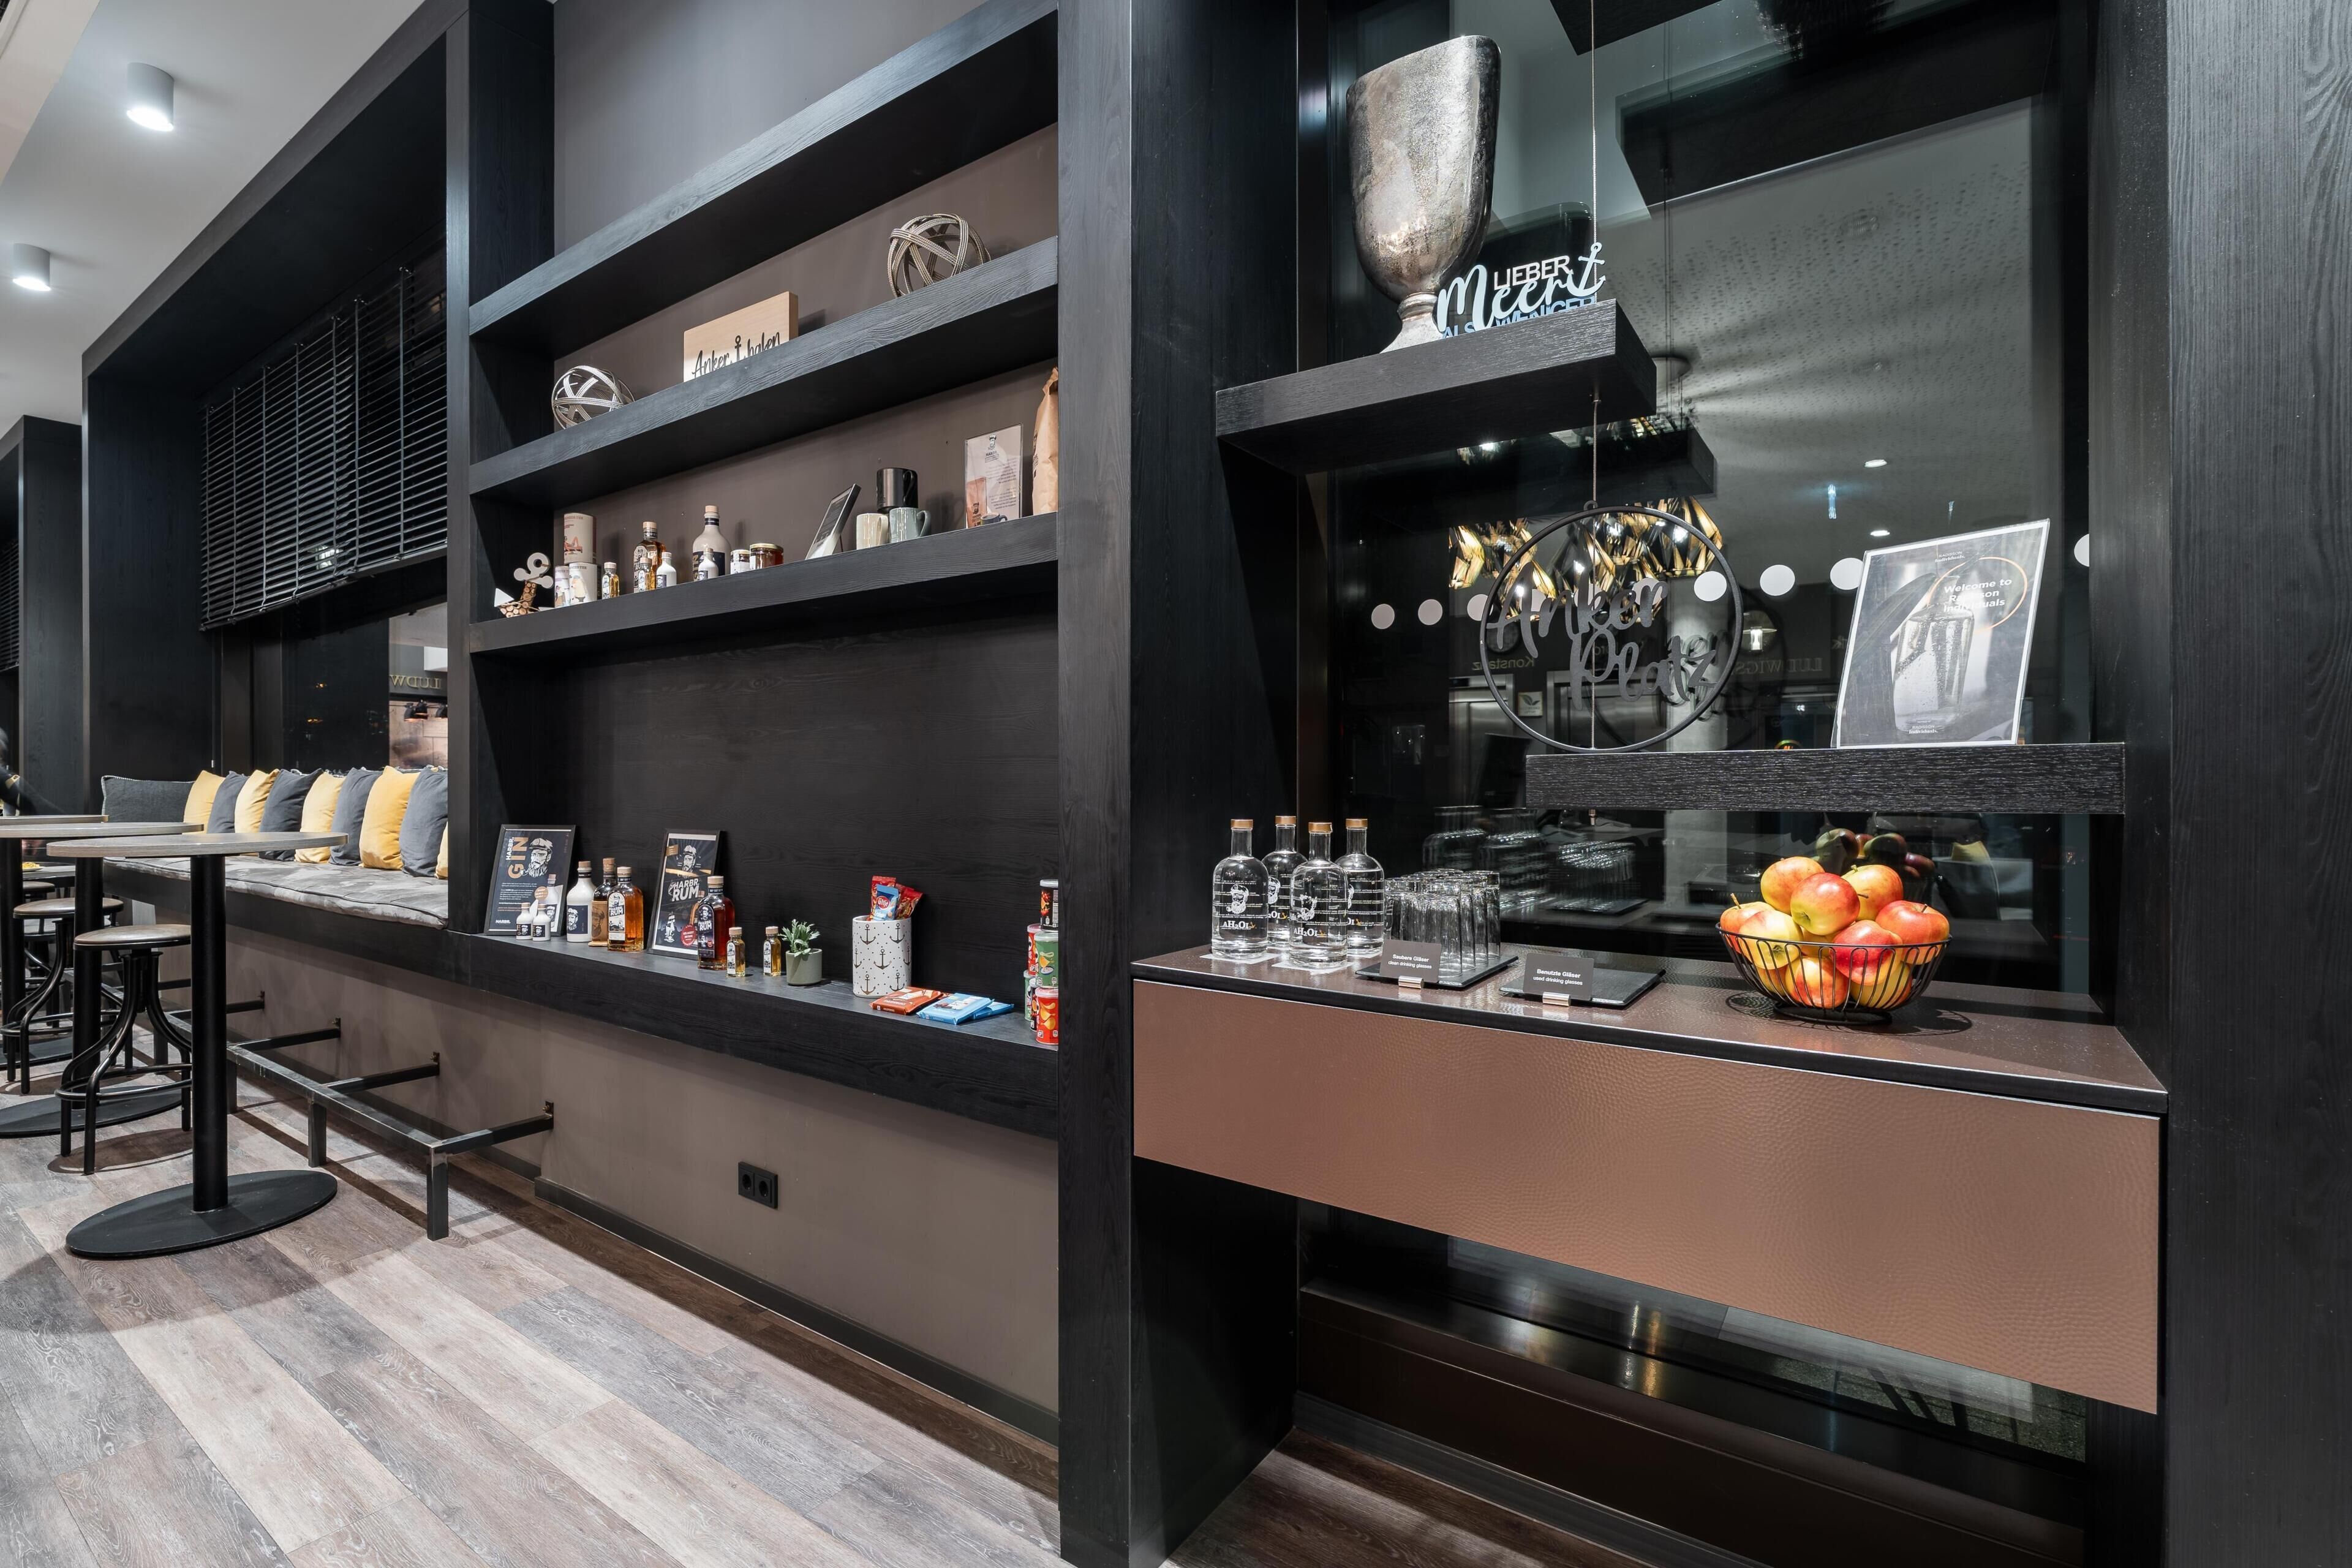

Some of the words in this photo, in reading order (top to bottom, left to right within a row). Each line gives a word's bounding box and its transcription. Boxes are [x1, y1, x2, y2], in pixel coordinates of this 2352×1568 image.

[1494, 255, 1570, 290] LIEBER
[692, 350, 729, 378] Anker
[1943, 581, 1996, 594] Welcome
[1948, 590, 2000, 603] Rason
[1487, 562, 1668, 658] Anker
[1570, 629, 1719, 710] Platz
[505, 837, 514, 861] HARBR.
[508, 837, 529, 879] GIN
[672, 886, 699, 902] RUM
[674, 878, 699, 889] HARBR.
